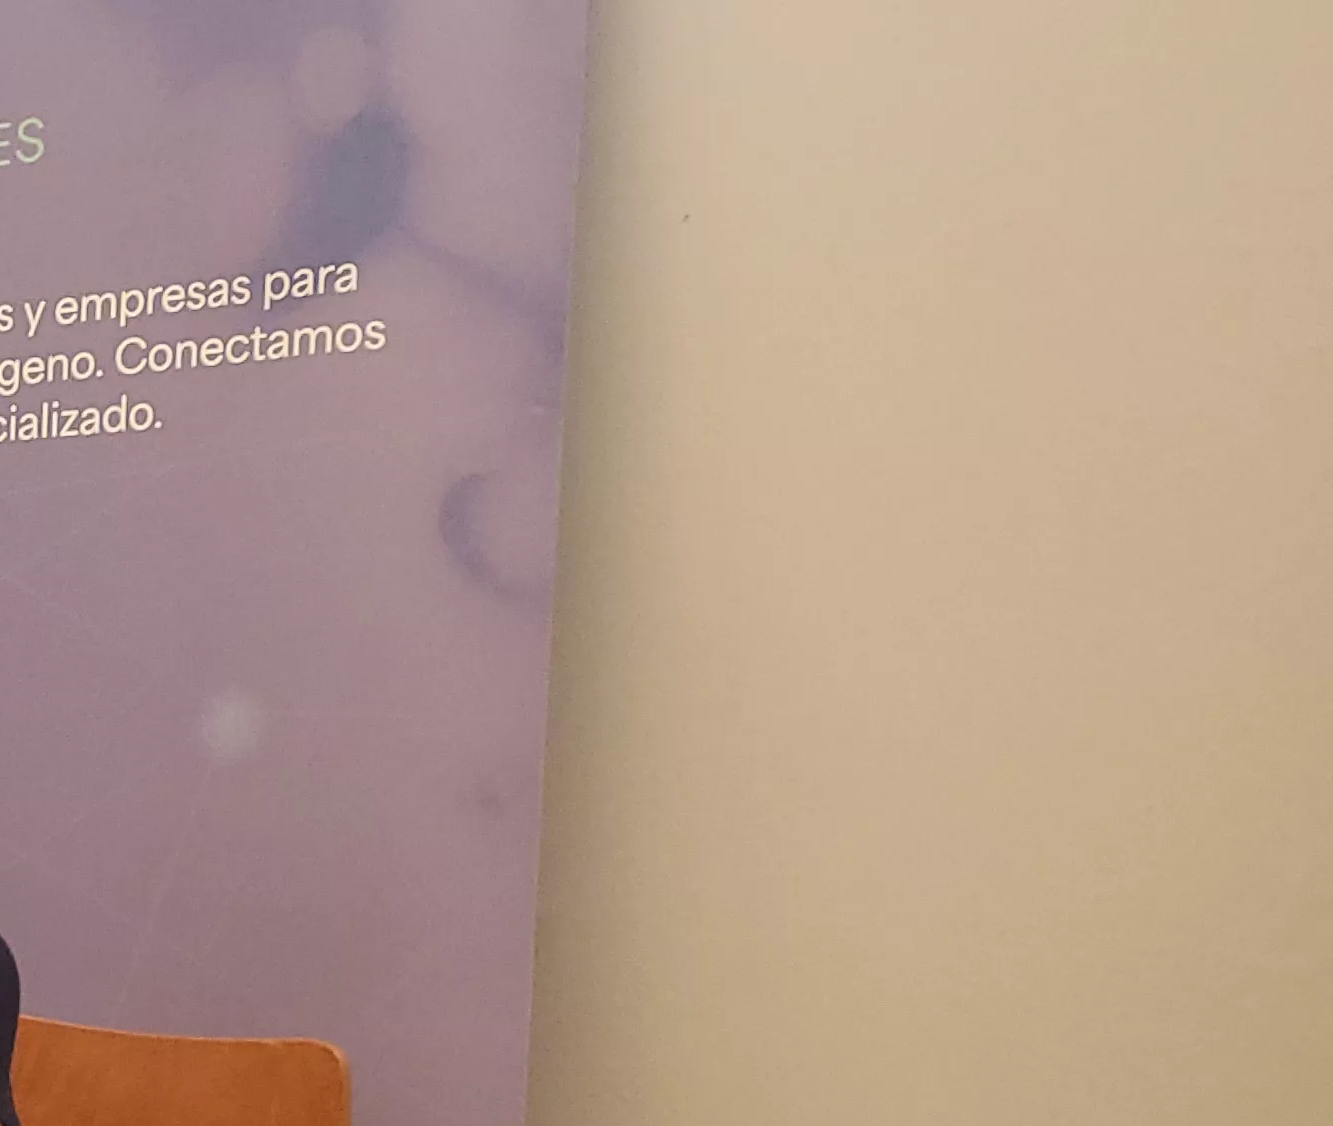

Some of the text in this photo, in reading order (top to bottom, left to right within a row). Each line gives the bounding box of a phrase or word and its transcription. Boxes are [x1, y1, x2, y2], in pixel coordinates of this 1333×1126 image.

[23, 300, 46, 337] y
[54, 274, 252, 327] empresas
[263, 261, 359, 309] para
[114, 319, 387, 376] Conectamos
